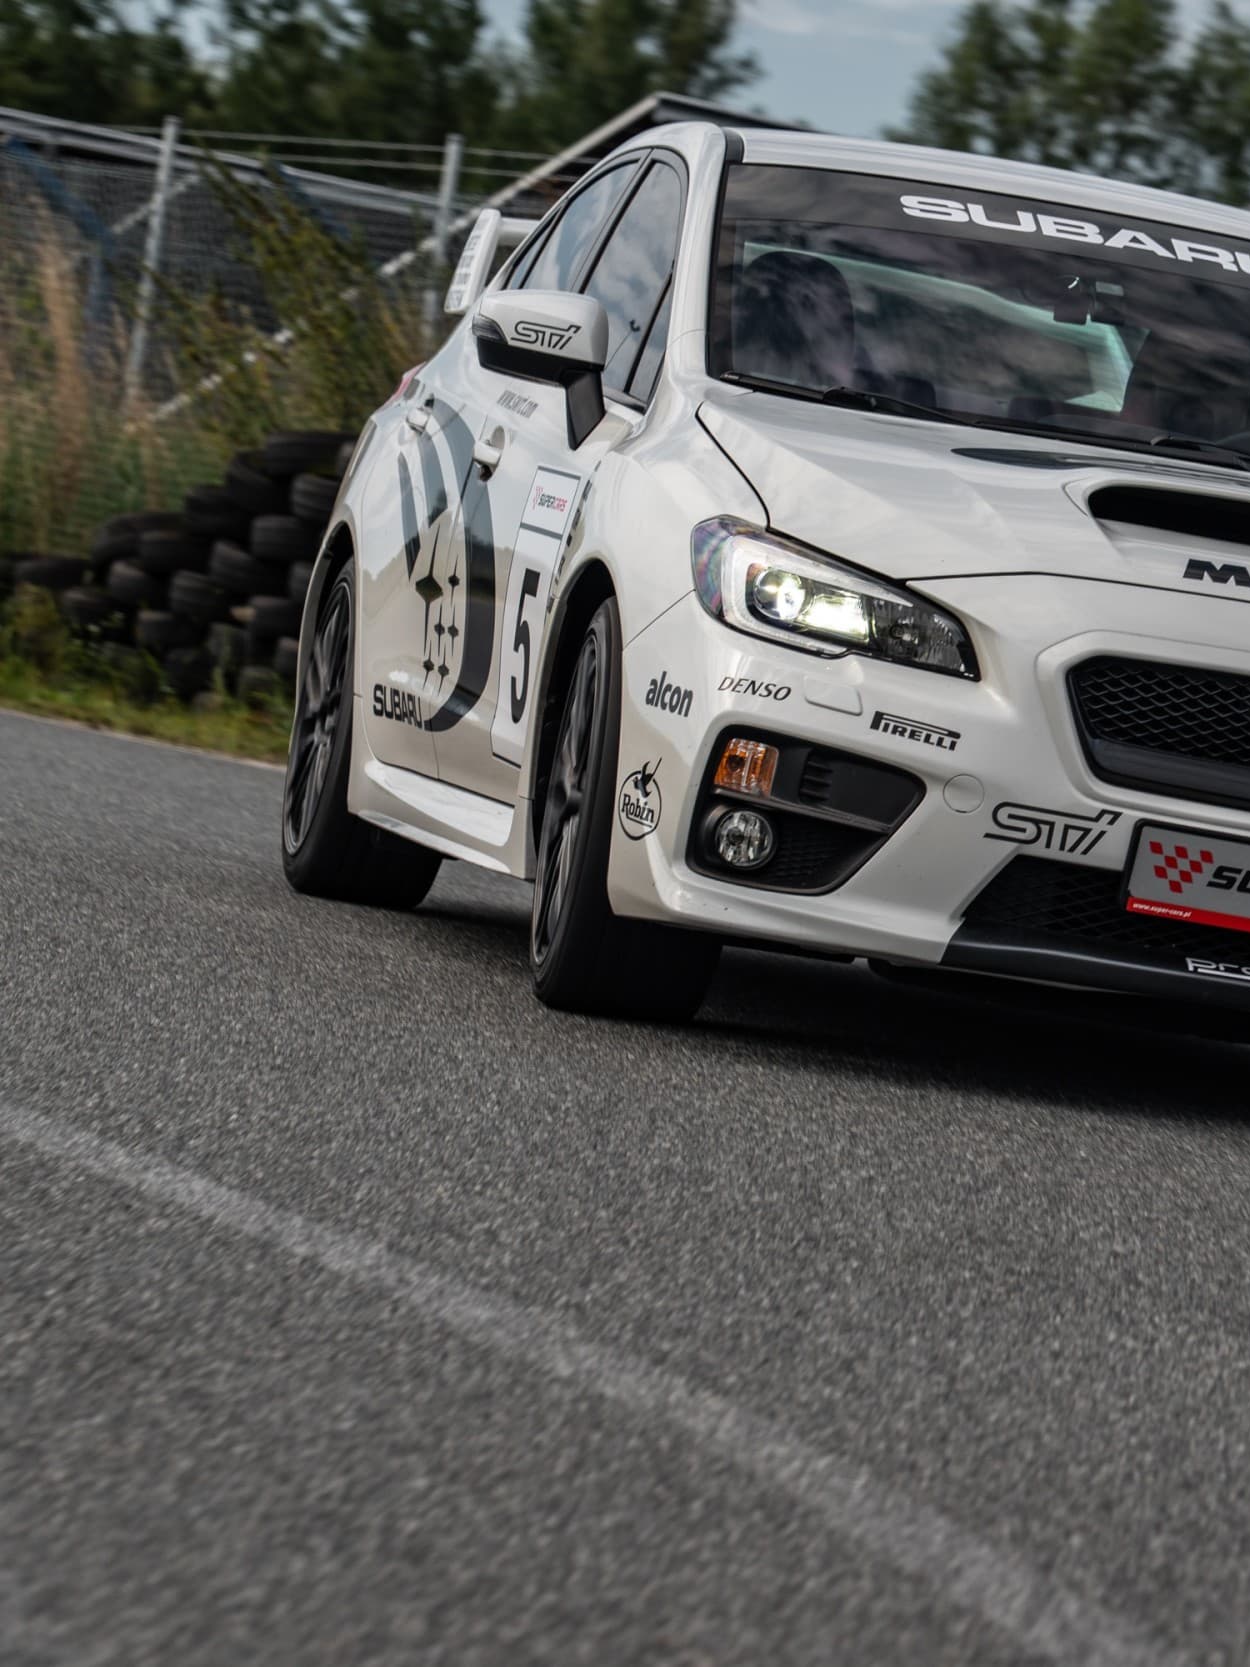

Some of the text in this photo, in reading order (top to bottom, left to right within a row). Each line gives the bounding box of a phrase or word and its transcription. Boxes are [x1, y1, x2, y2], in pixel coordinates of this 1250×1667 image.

[511, 568, 540, 724] 5
[373, 684, 424, 729] SUBARU
[645, 671, 694, 717] alcon
[718, 676, 792, 701] DENSO
[869, 711, 961, 751] PIRELLI
[621, 795, 655, 824] Robin
